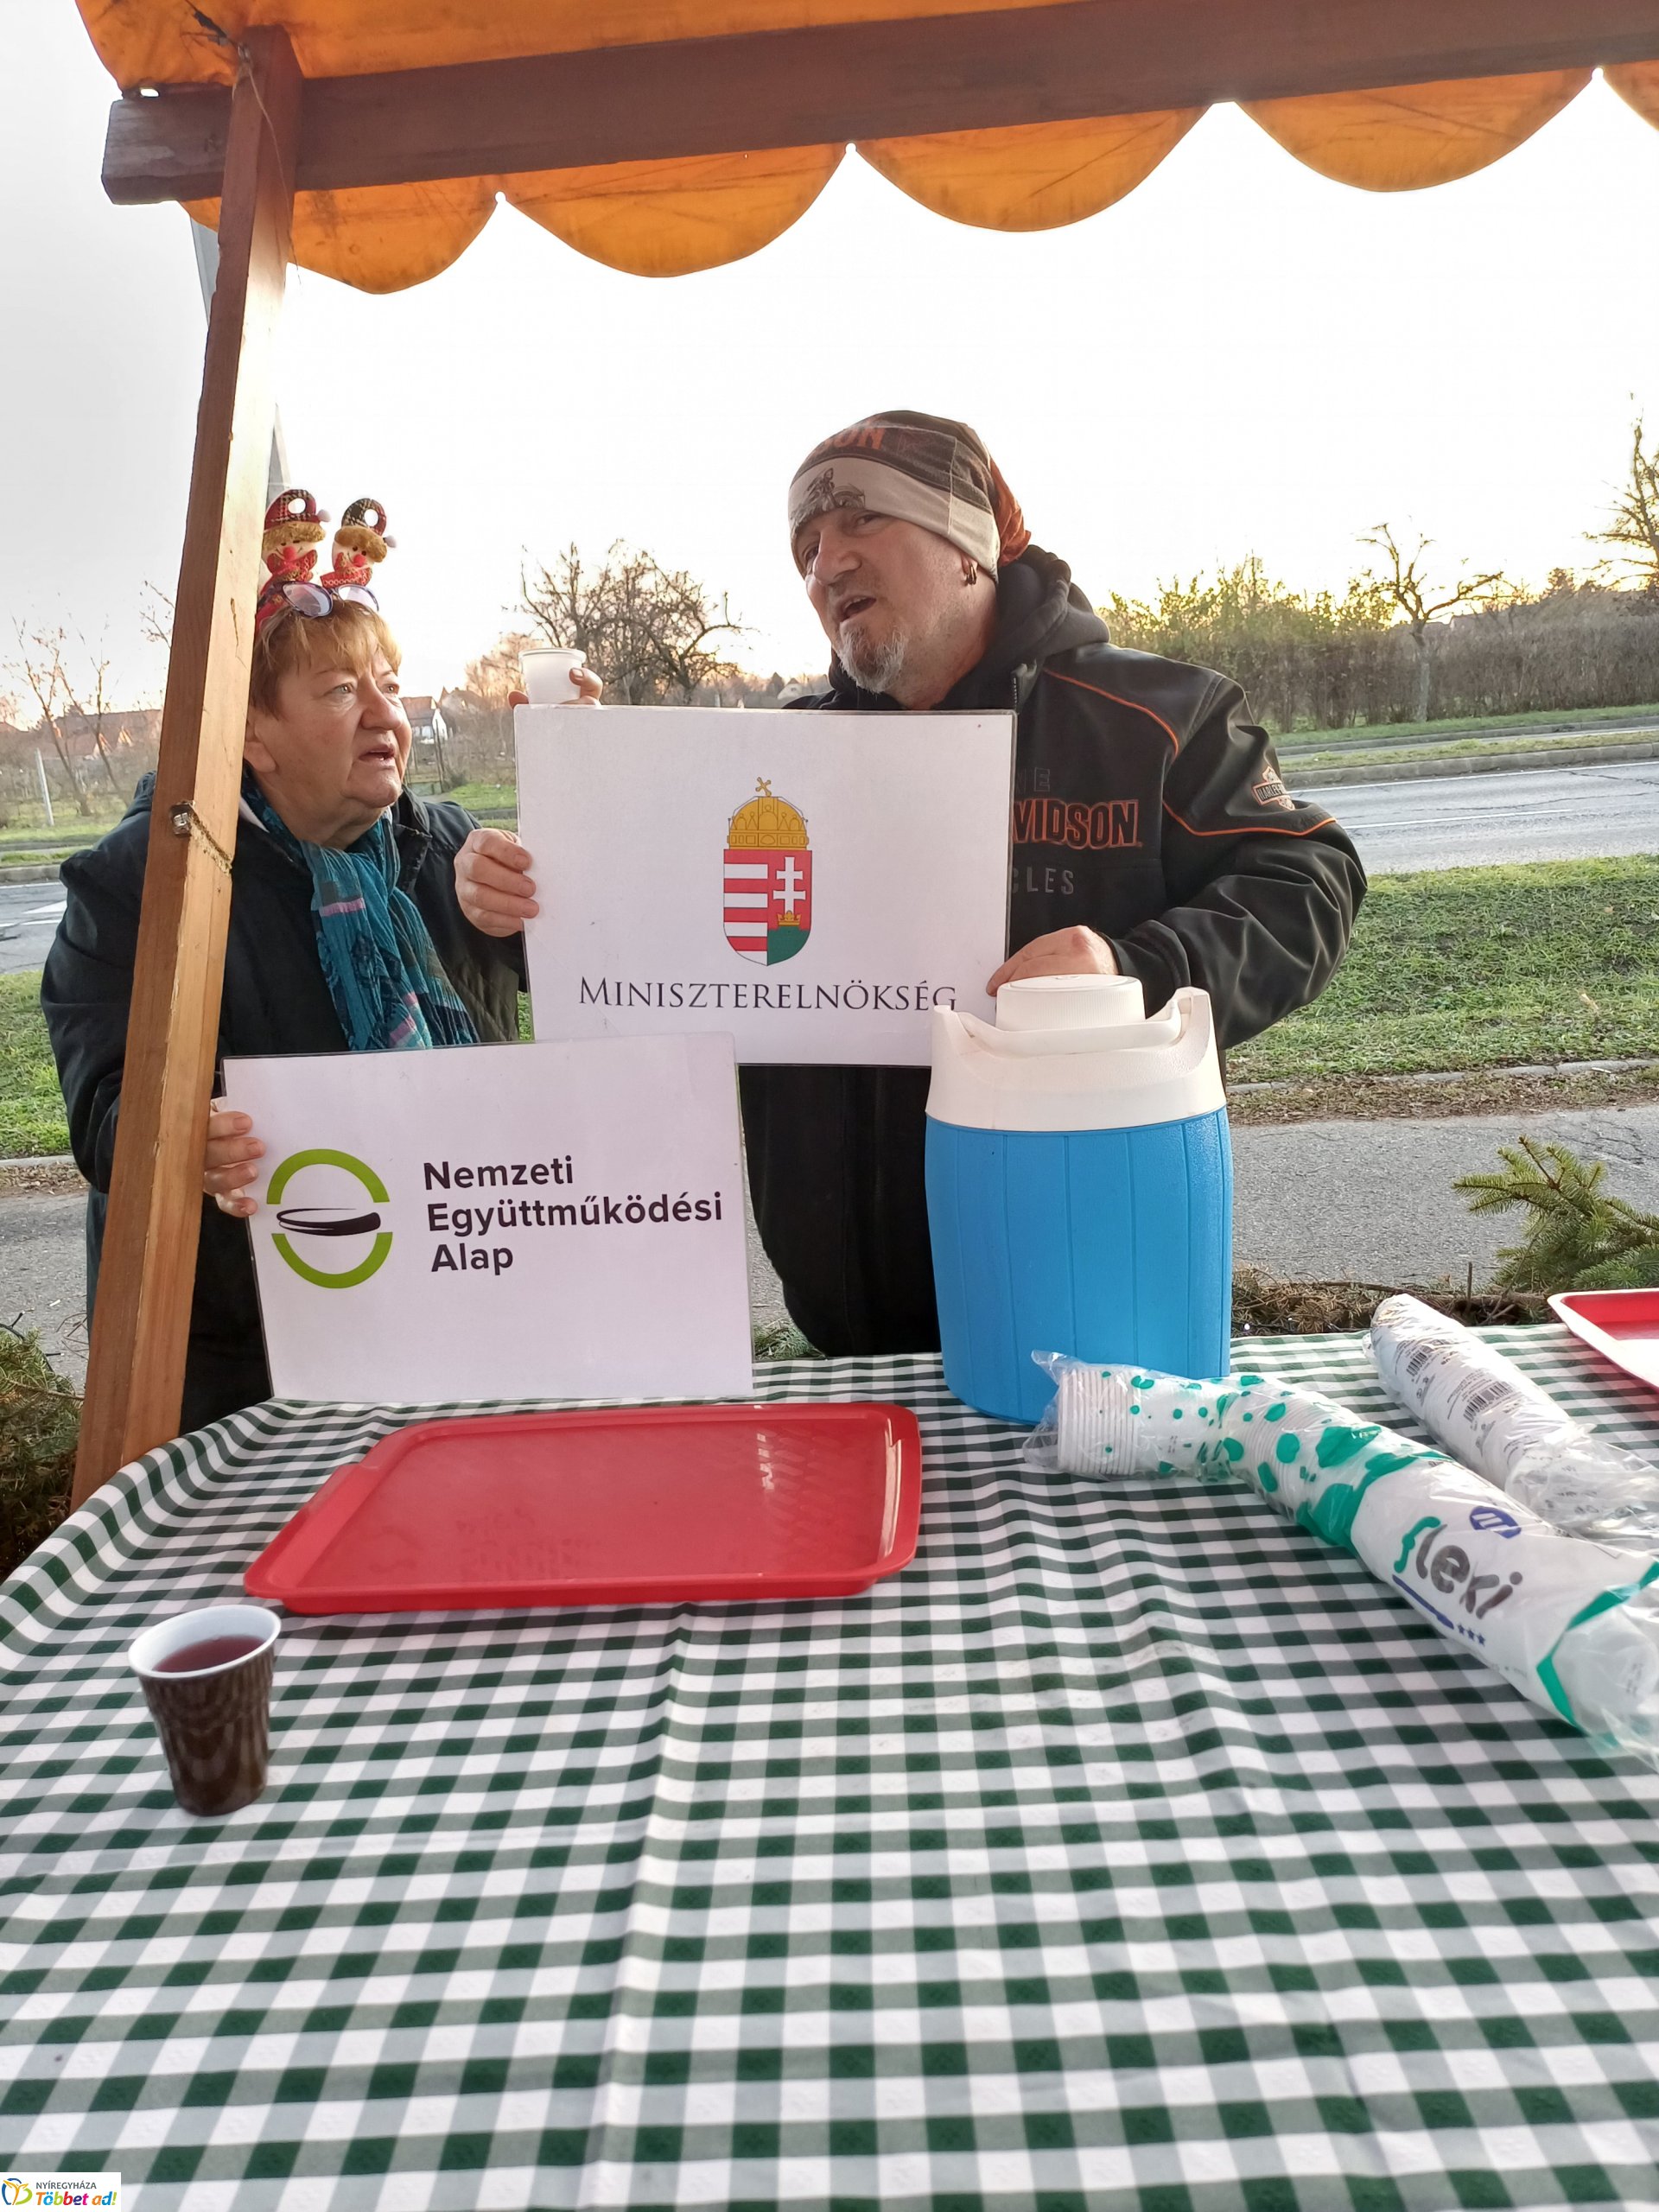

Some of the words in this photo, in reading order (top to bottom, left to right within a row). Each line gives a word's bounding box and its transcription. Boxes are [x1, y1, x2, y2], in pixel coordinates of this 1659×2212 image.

[580, 976, 955, 1010] MINISZTERELNÖKSÉG
[424, 1155, 573, 1190] Nemzeti
[428, 1192, 721, 1236] Együttműködési
[431, 1243, 512, 1275] Alap
